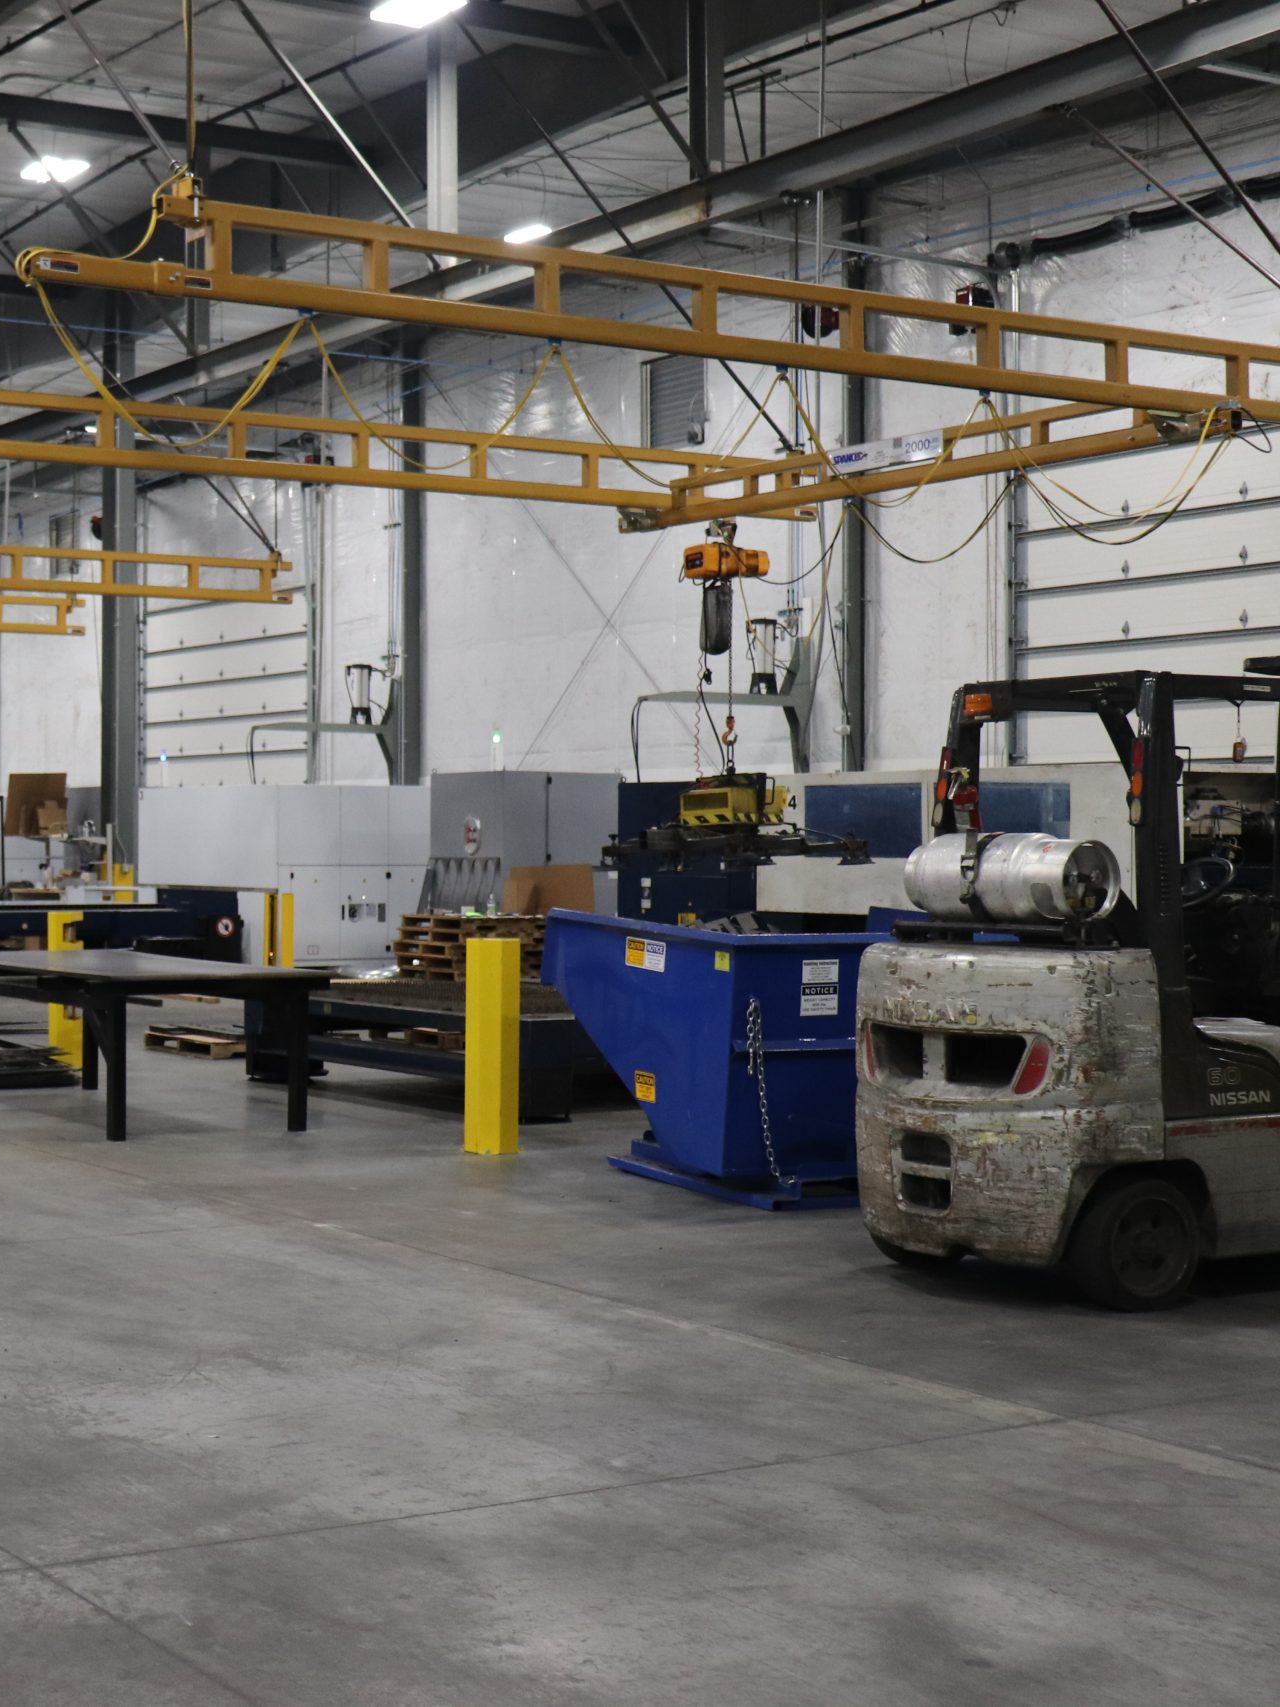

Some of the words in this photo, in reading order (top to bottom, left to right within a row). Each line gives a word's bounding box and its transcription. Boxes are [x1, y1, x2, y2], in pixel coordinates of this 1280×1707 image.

[833, 451, 866, 465] SPANCO
[905, 439, 931, 454] 2000
[788, 795, 797, 810] 4
[646, 944, 664, 954] NOTICE
[804, 987, 835, 995] NOTICE
[1208, 1066, 1241, 1086] 60
[1209, 1090, 1271, 1106] NISSAN
